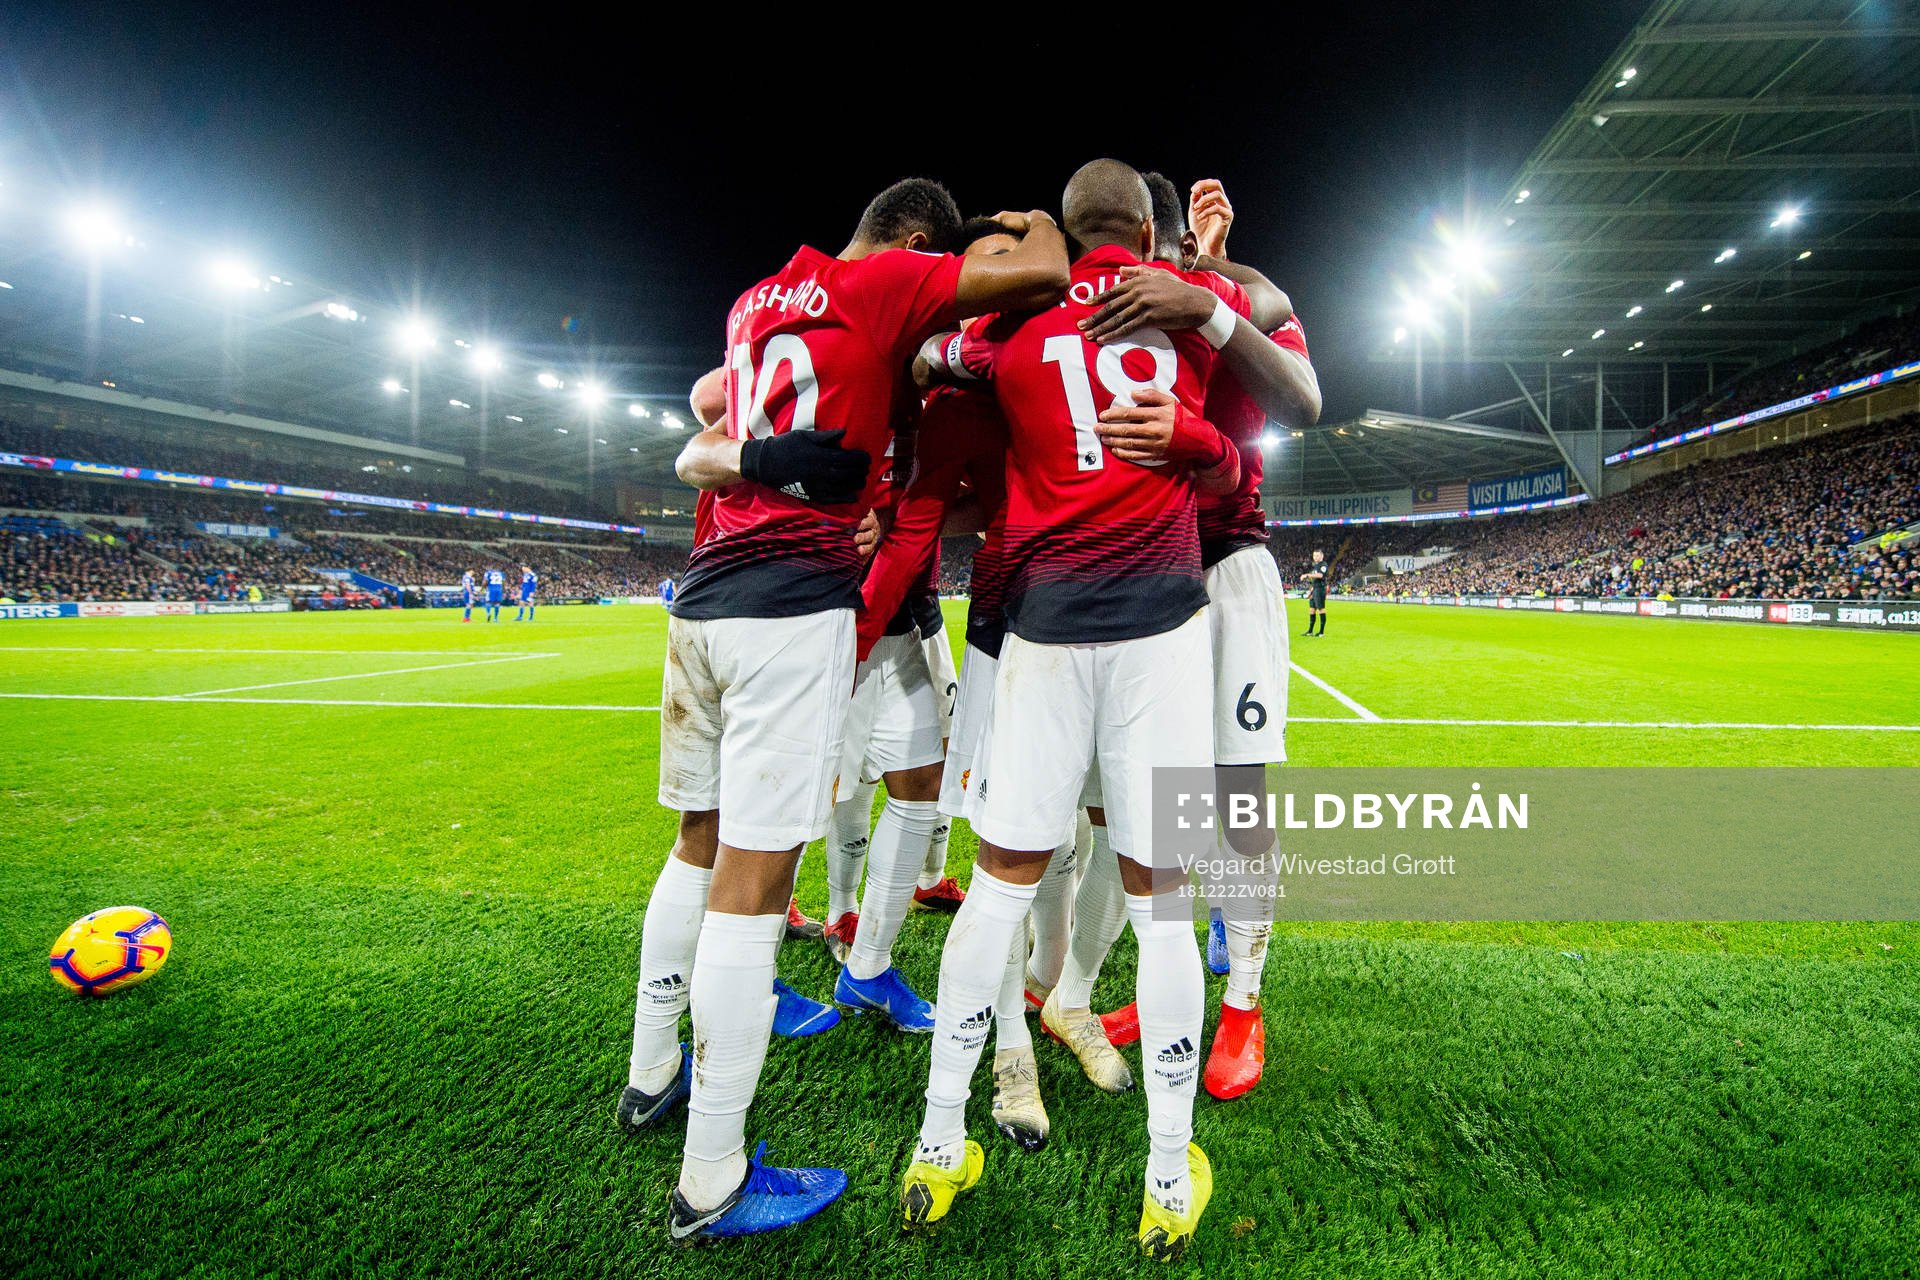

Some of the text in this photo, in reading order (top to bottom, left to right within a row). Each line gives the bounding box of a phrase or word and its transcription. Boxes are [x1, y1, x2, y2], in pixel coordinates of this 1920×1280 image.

[731, 333, 819, 441] 10
[1041, 328, 1178, 472] 18
[780, 487, 810, 501] adidas
[1472, 472, 1564, 505] VISIT MALAYSIA
[1273, 495, 1391, 517] VISIT PHILIPPINES
[1384, 558, 1415, 570] CMB
[1236, 682, 1267, 732] 6
[648, 980, 687, 991] adidas
[1157, 1050, 1198, 1063] adidas
[1168, 1074, 1193, 1088] UNITED
